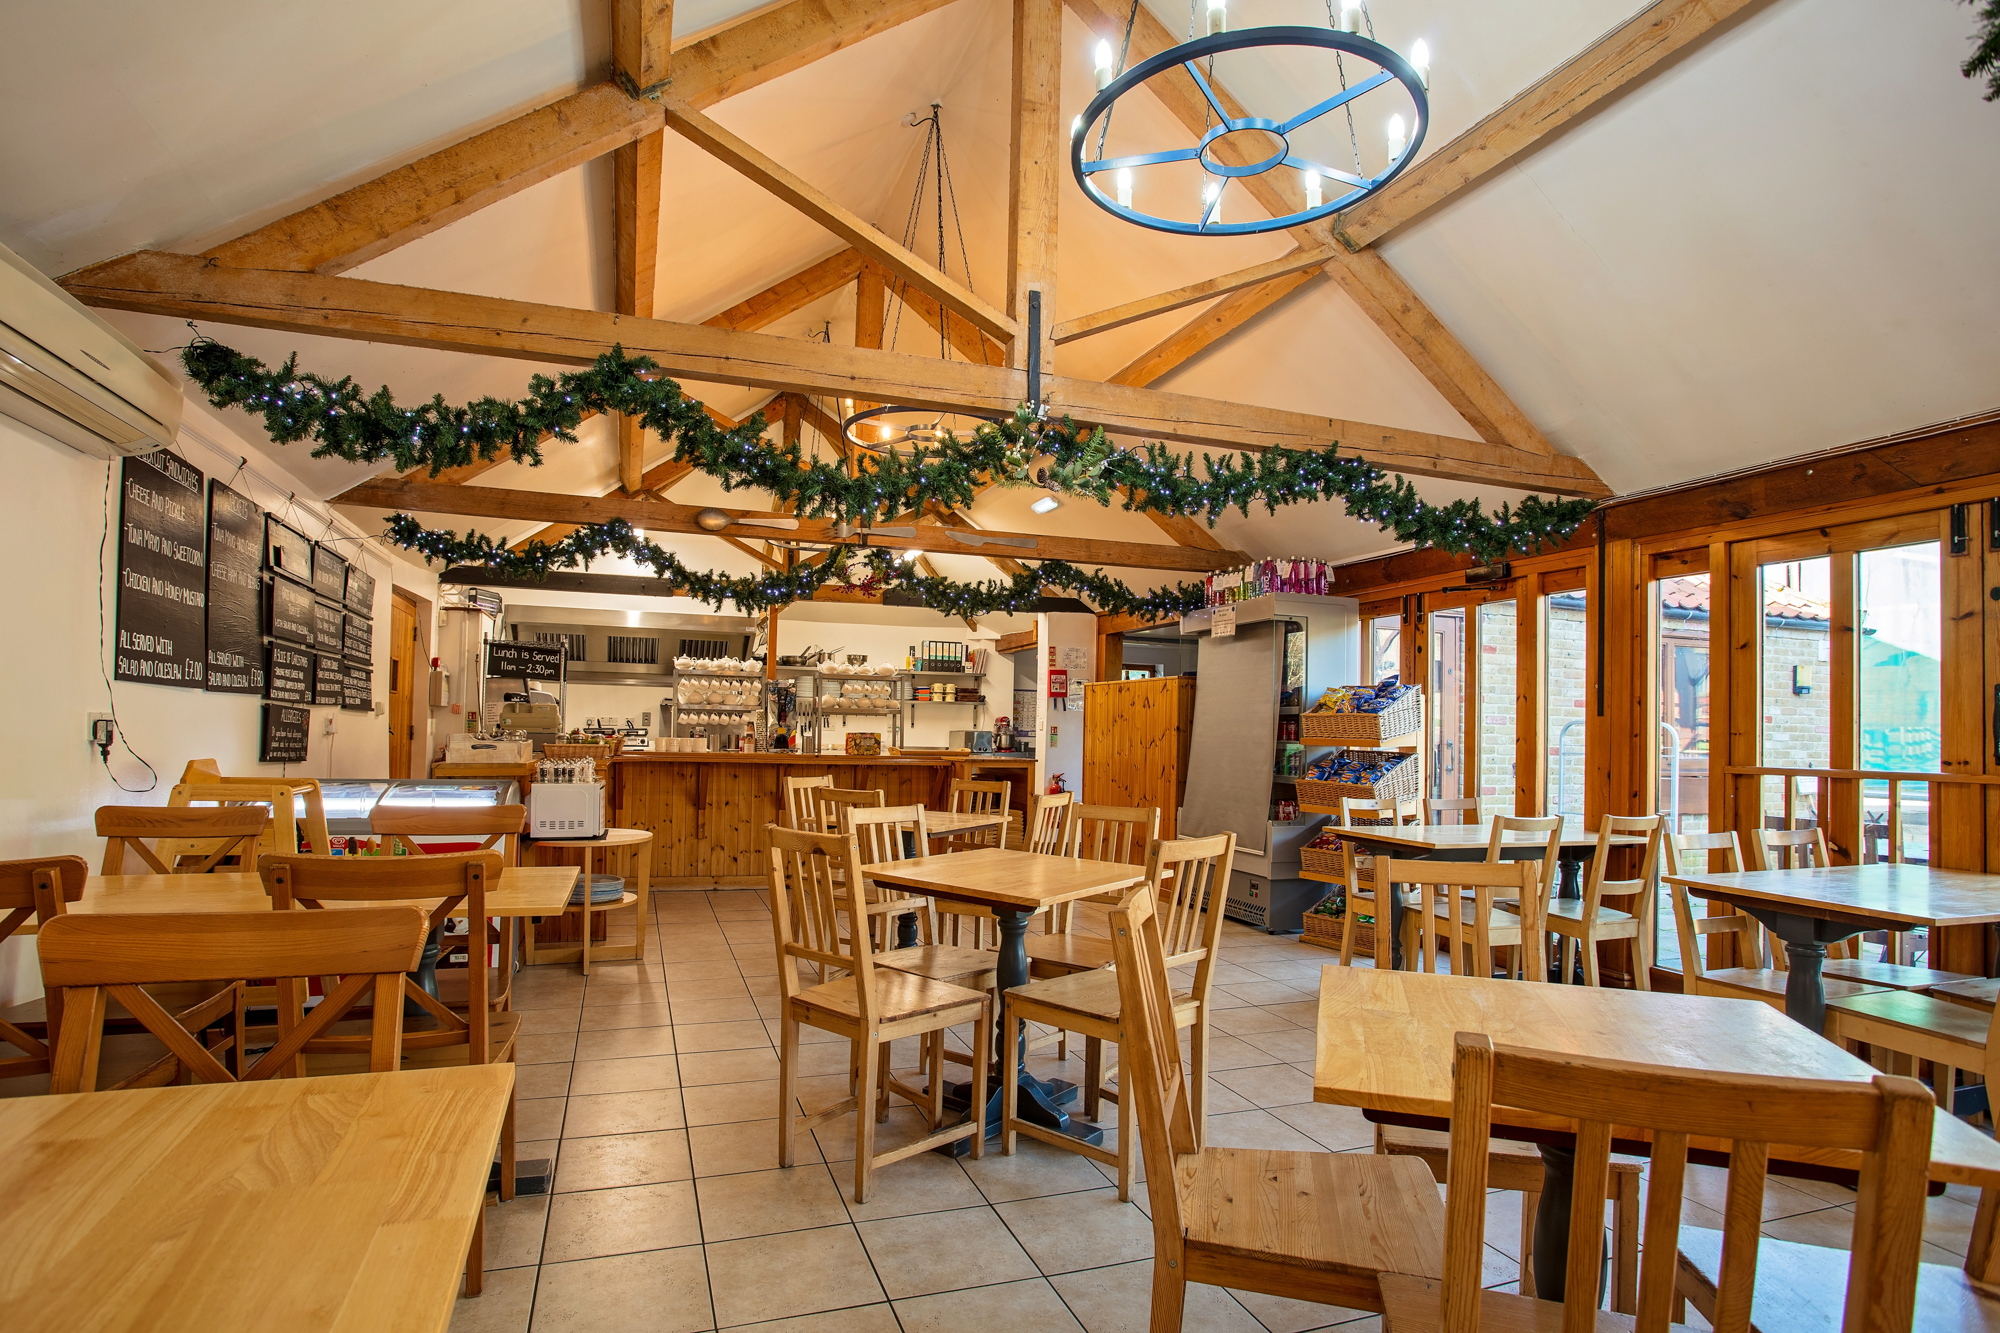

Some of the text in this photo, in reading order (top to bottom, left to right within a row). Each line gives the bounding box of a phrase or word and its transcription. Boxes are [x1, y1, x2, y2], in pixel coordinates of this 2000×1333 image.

[166, 455, 199, 492] SANDWICHES
[151, 490, 164, 512] AND
[165, 496, 186, 522] PICKLE
[143, 529, 160, 553] MAYO
[161, 537, 173, 558] AND
[173, 541, 204, 567] SWEETCORN
[151, 576, 164, 597] AND
[164, 580, 183, 602] HONEY
[182, 587, 205, 608] MUSTARD
[119, 629, 173, 657] ALL SERVED WITH
[493, 646, 560, 664] Lunch is Served
[118, 655, 203, 681] SALAD AND COLESLAW £7.00
[501, 660, 516, 671] 11am
[526, 663, 555, 677] 2:30pm
